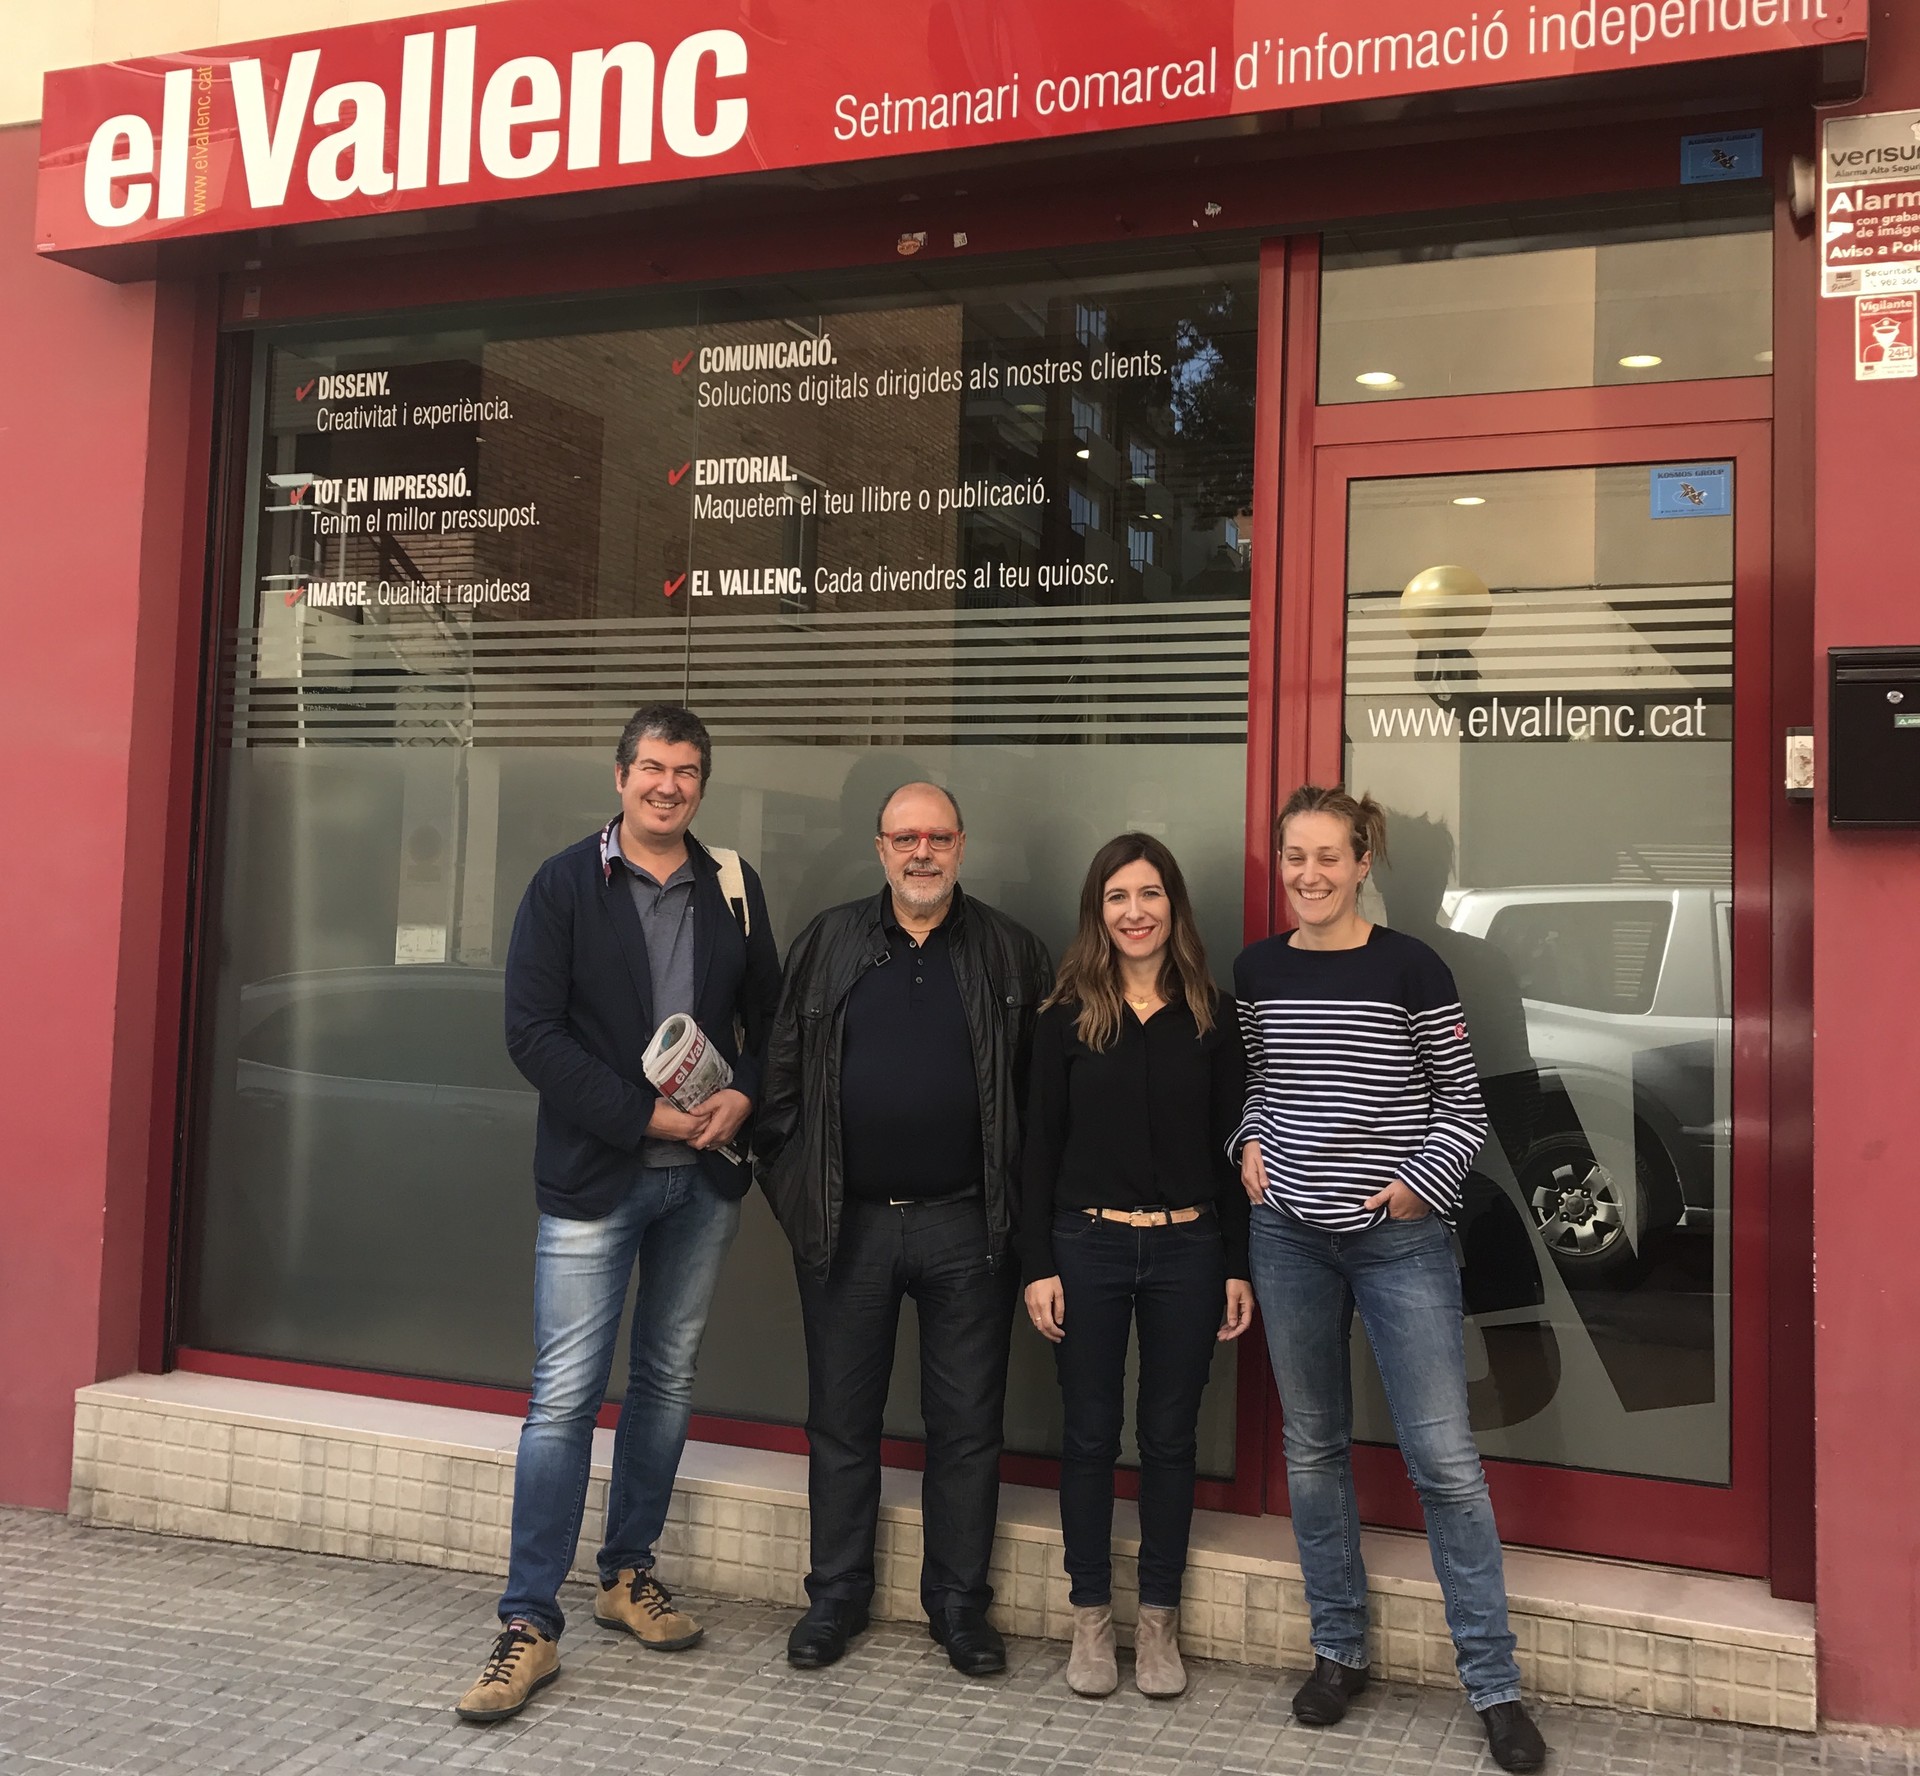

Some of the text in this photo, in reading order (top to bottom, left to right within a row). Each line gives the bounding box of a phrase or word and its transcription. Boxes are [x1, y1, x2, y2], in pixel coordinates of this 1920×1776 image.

[833, 72, 1019, 141] Setmanari
[1035, 47, 1217, 115] comarcal
[1234, 10, 1509, 90] d'informació
[83, 25, 748, 228] el Vallenc
[192, 65, 213, 216] www.elvallenc.cat
[1835, 167, 1868, 177] Alarma
[1870, 166, 1889, 174] Alta
[1856, 216, 1878, 226] con
[1856, 226, 1874, 238] de
[1829, 244, 1874, 260] Aviso
[1877, 245, 1888, 255] a
[1864, 267, 1913, 278] Securitas
[1860, 299, 1913, 313] Vigilante
[699, 335, 838, 374] COMUNICACIÓ.
[1888, 347, 1911, 358] 24H
[317, 371, 391, 402] DISSENY.
[698, 349, 1169, 409] Solucions digitals dirigides als nostres clients.
[316, 397, 514, 431] Creativitat i experiència.
[312, 468, 472, 505] TOT EN IMPRESSIÓ.
[694, 455, 798, 487] EDITORIAL.
[694, 476, 1051, 524] Maquetem el teu llibre o publicació.
[311, 502, 540, 534] Tenim el millor pressupost.
[307, 577, 531, 608] IMATGE. Qualitat i rapidesa
[691, 562, 1116, 597] EL VALLENC. Cada divendres al teu quiosc.
[1367, 696, 1707, 738] www.elvallenc.cat
[674, 1065, 690, 1085] el
